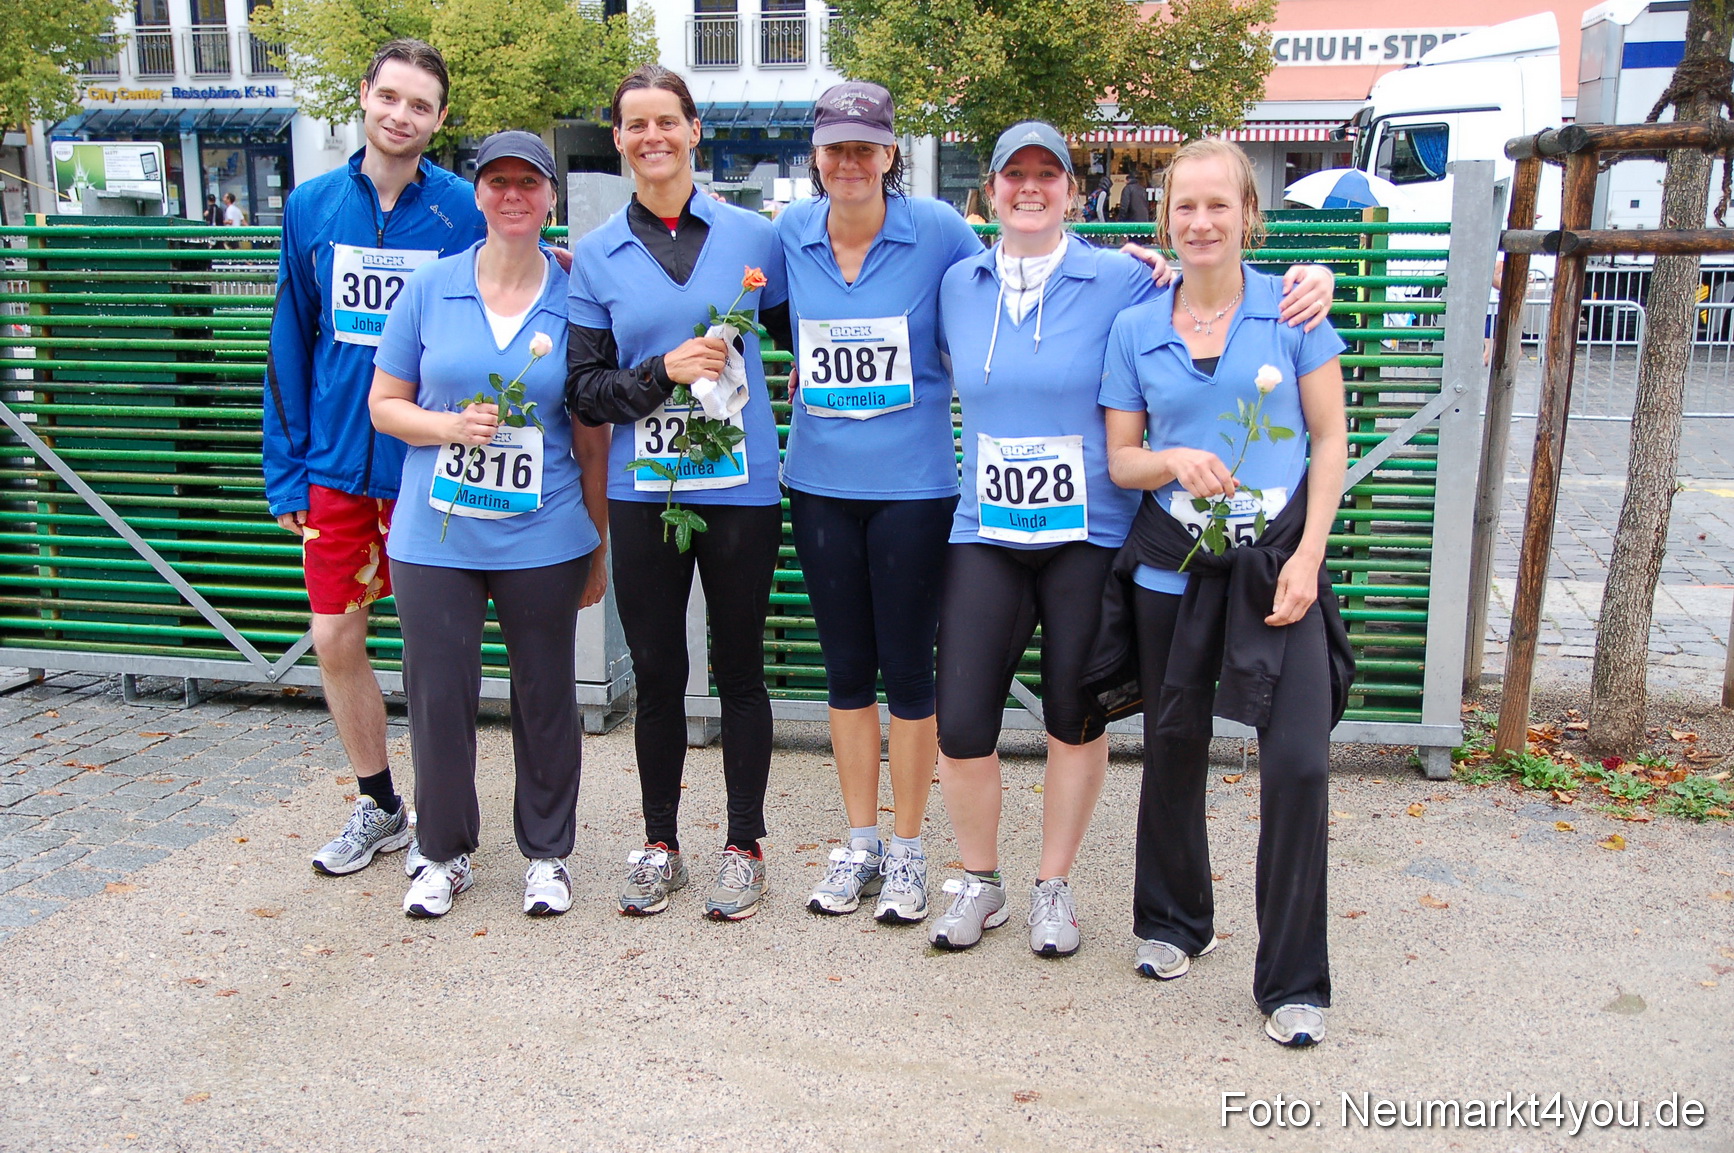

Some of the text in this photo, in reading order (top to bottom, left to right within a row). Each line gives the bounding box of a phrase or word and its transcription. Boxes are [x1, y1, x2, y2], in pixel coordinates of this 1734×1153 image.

[88, 87, 163, 103] City Center
[171, 86, 243, 99] Reisebüro
[362, 254, 405, 266] BOCK
[352, 316, 386, 332] Joha
[830, 326, 872, 336] BOCK
[812, 346, 898, 384] 3087
[827, 391, 886, 407] Cornelia
[1000, 444, 1046, 456] BOCK
[445, 442, 533, 489] 3316
[985, 463, 1075, 505] 3028
[456, 489, 510, 509] Martina
[1009, 512, 1047, 529] Linda
